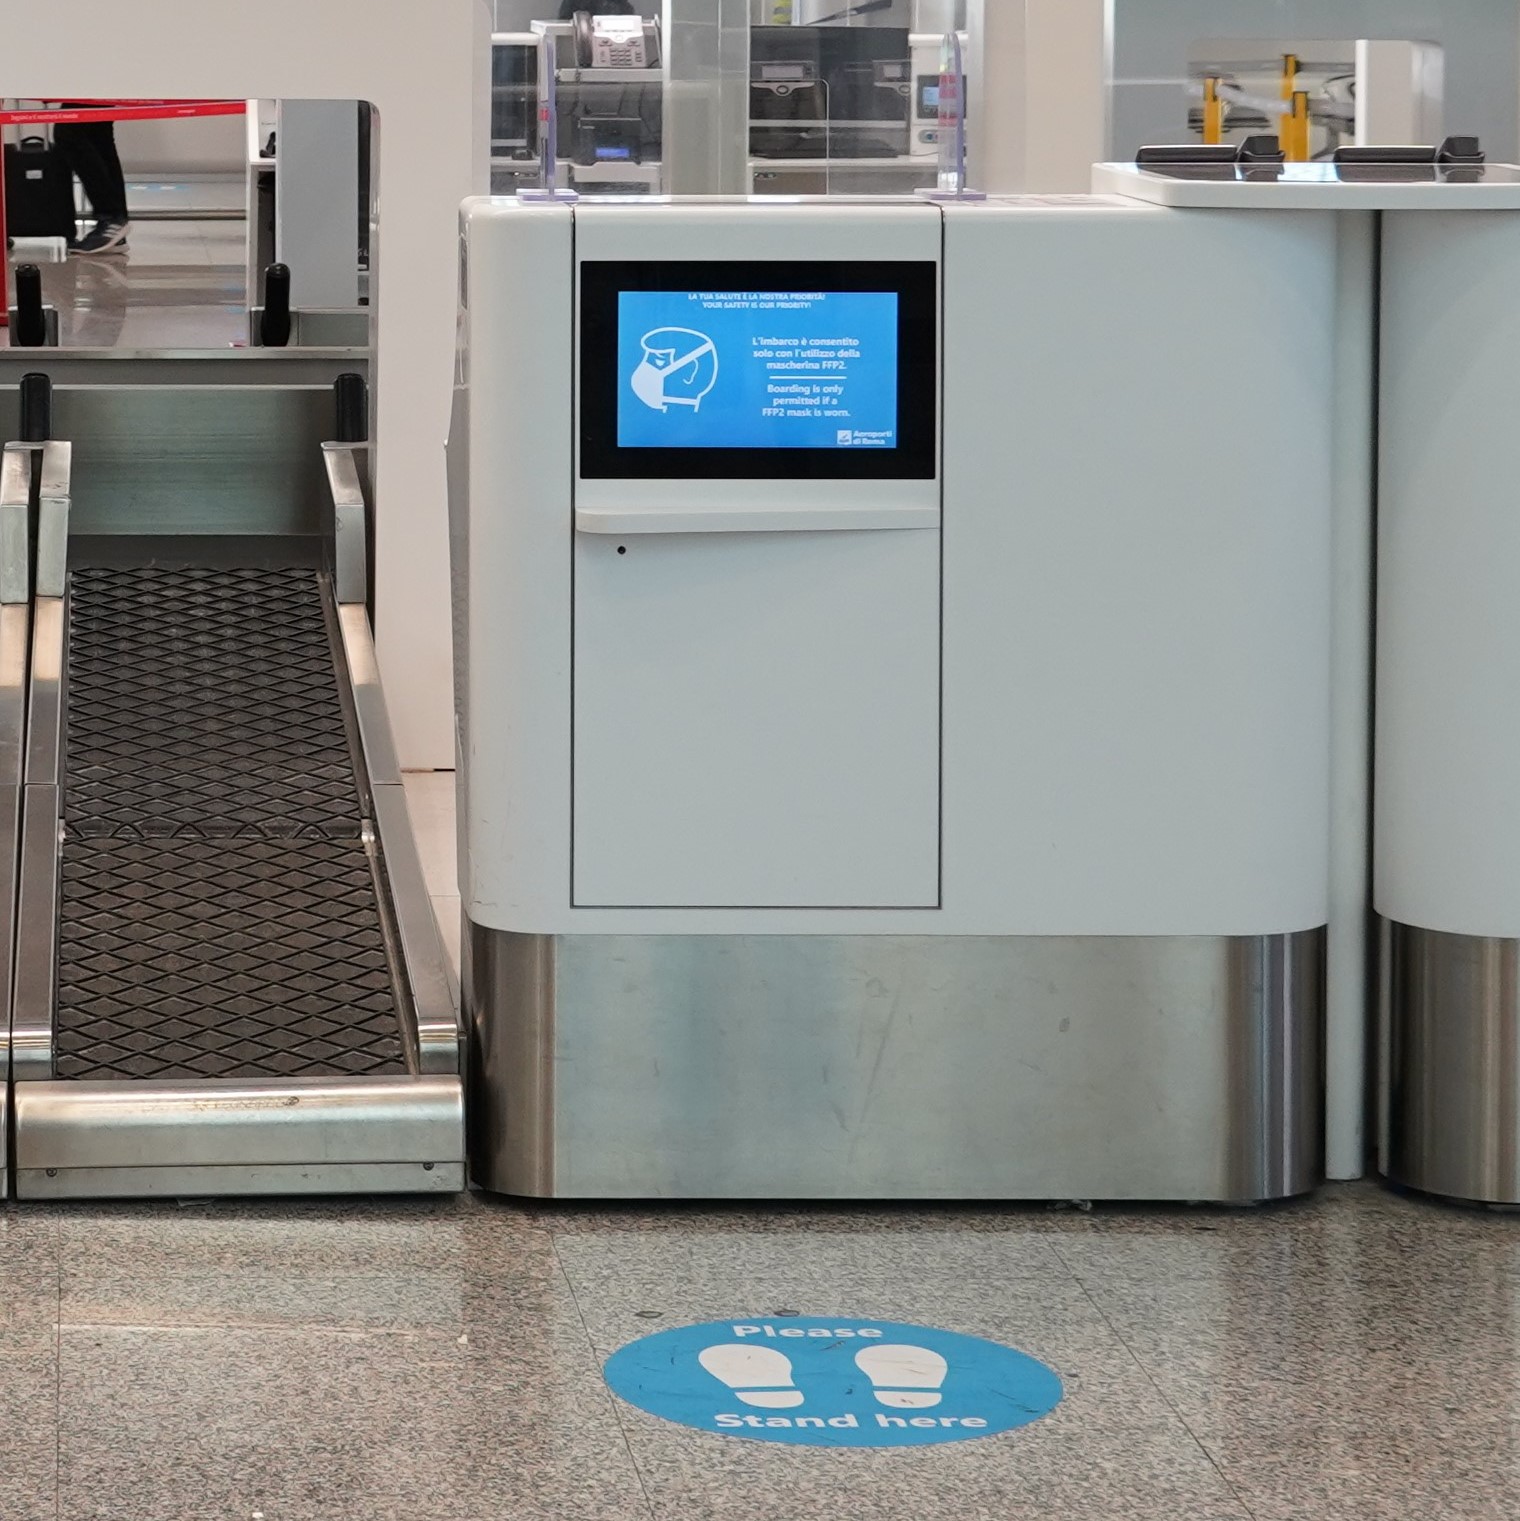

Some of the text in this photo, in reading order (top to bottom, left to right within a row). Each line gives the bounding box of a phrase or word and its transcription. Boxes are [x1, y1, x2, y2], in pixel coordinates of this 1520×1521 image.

[809, 337, 860, 346] consentito
[753, 349, 774, 358] solo
[775, 350, 793, 358] con
[837, 349, 860, 358] della
[766, 361, 820, 370] mascherina
[767, 384, 844, 395] Boarding is only
[773, 396, 820, 407] permitted
[822, 396, 831, 405] if
[762, 408, 785, 417] FFP2
[787, 408, 812, 417] mask
[814, 408, 822, 417] is
[732, 1324, 884, 1339] Please
[713, 1413, 989, 1429] Stand here
